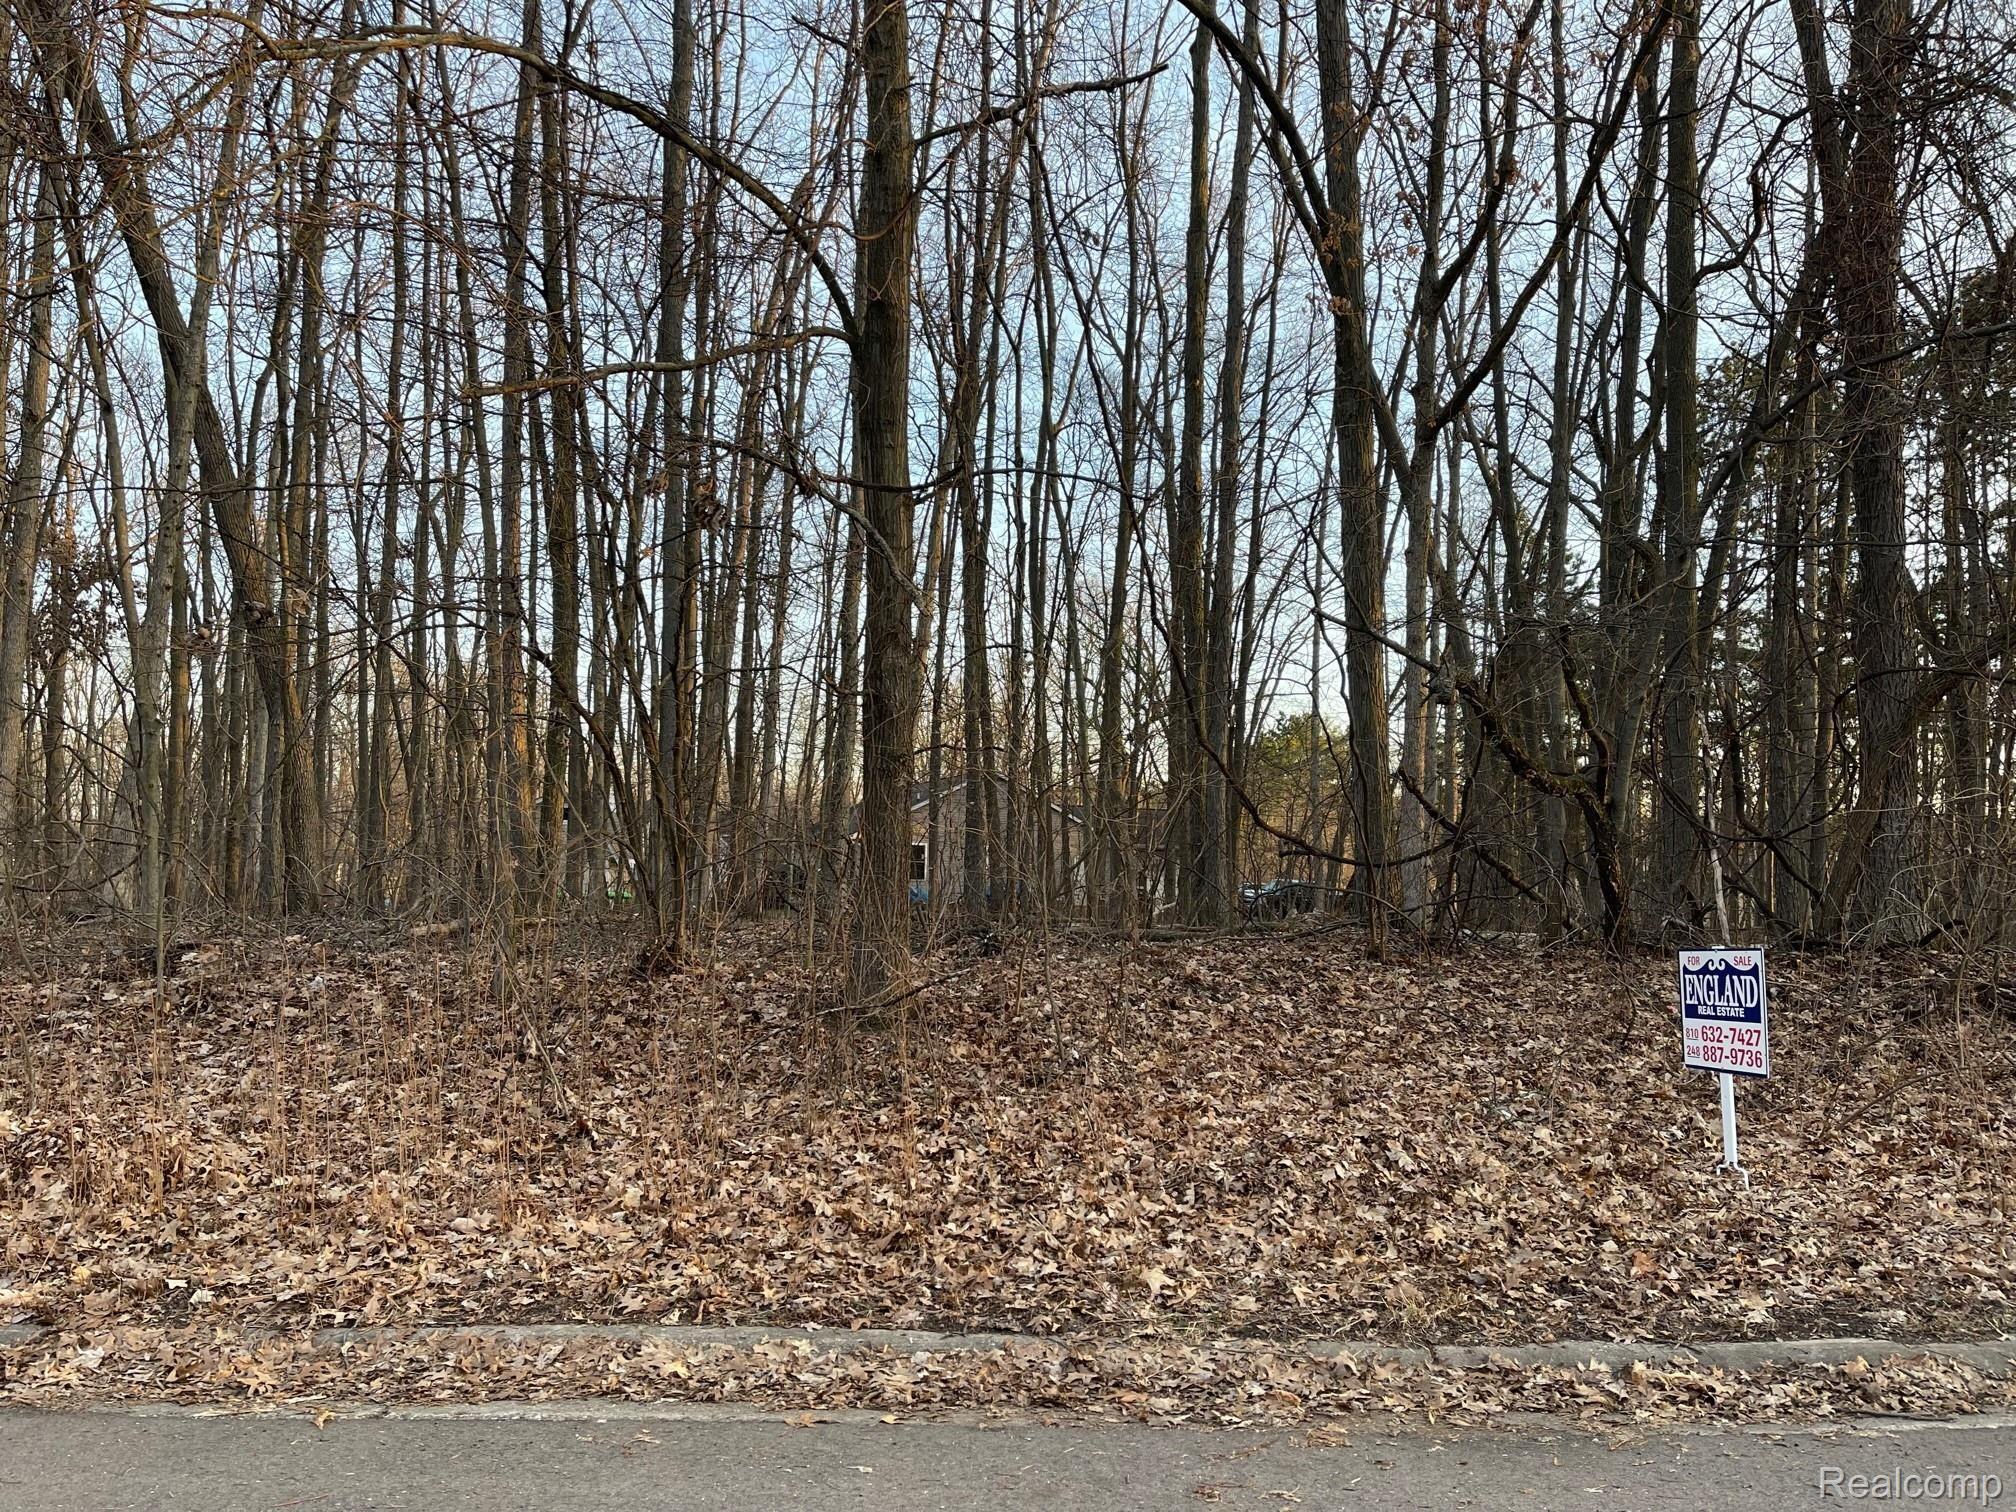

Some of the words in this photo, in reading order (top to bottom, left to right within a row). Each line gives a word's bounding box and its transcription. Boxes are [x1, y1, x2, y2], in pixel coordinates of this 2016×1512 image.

[1687, 956, 1700, 966] FOR
[1733, 956, 1752, 966] SALE
[1685, 974, 1759, 1008] ENGLAND
[1698, 1006, 1715, 1015] REAL
[1717, 1007, 1745, 1018] ESTATE
[1686, 1028, 1699, 1039] 810
[1701, 1025, 1761, 1047] 632-7427
[1687, 1045, 1700, 1056] 248
[1703, 1045, 1763, 1068] 887-9736
